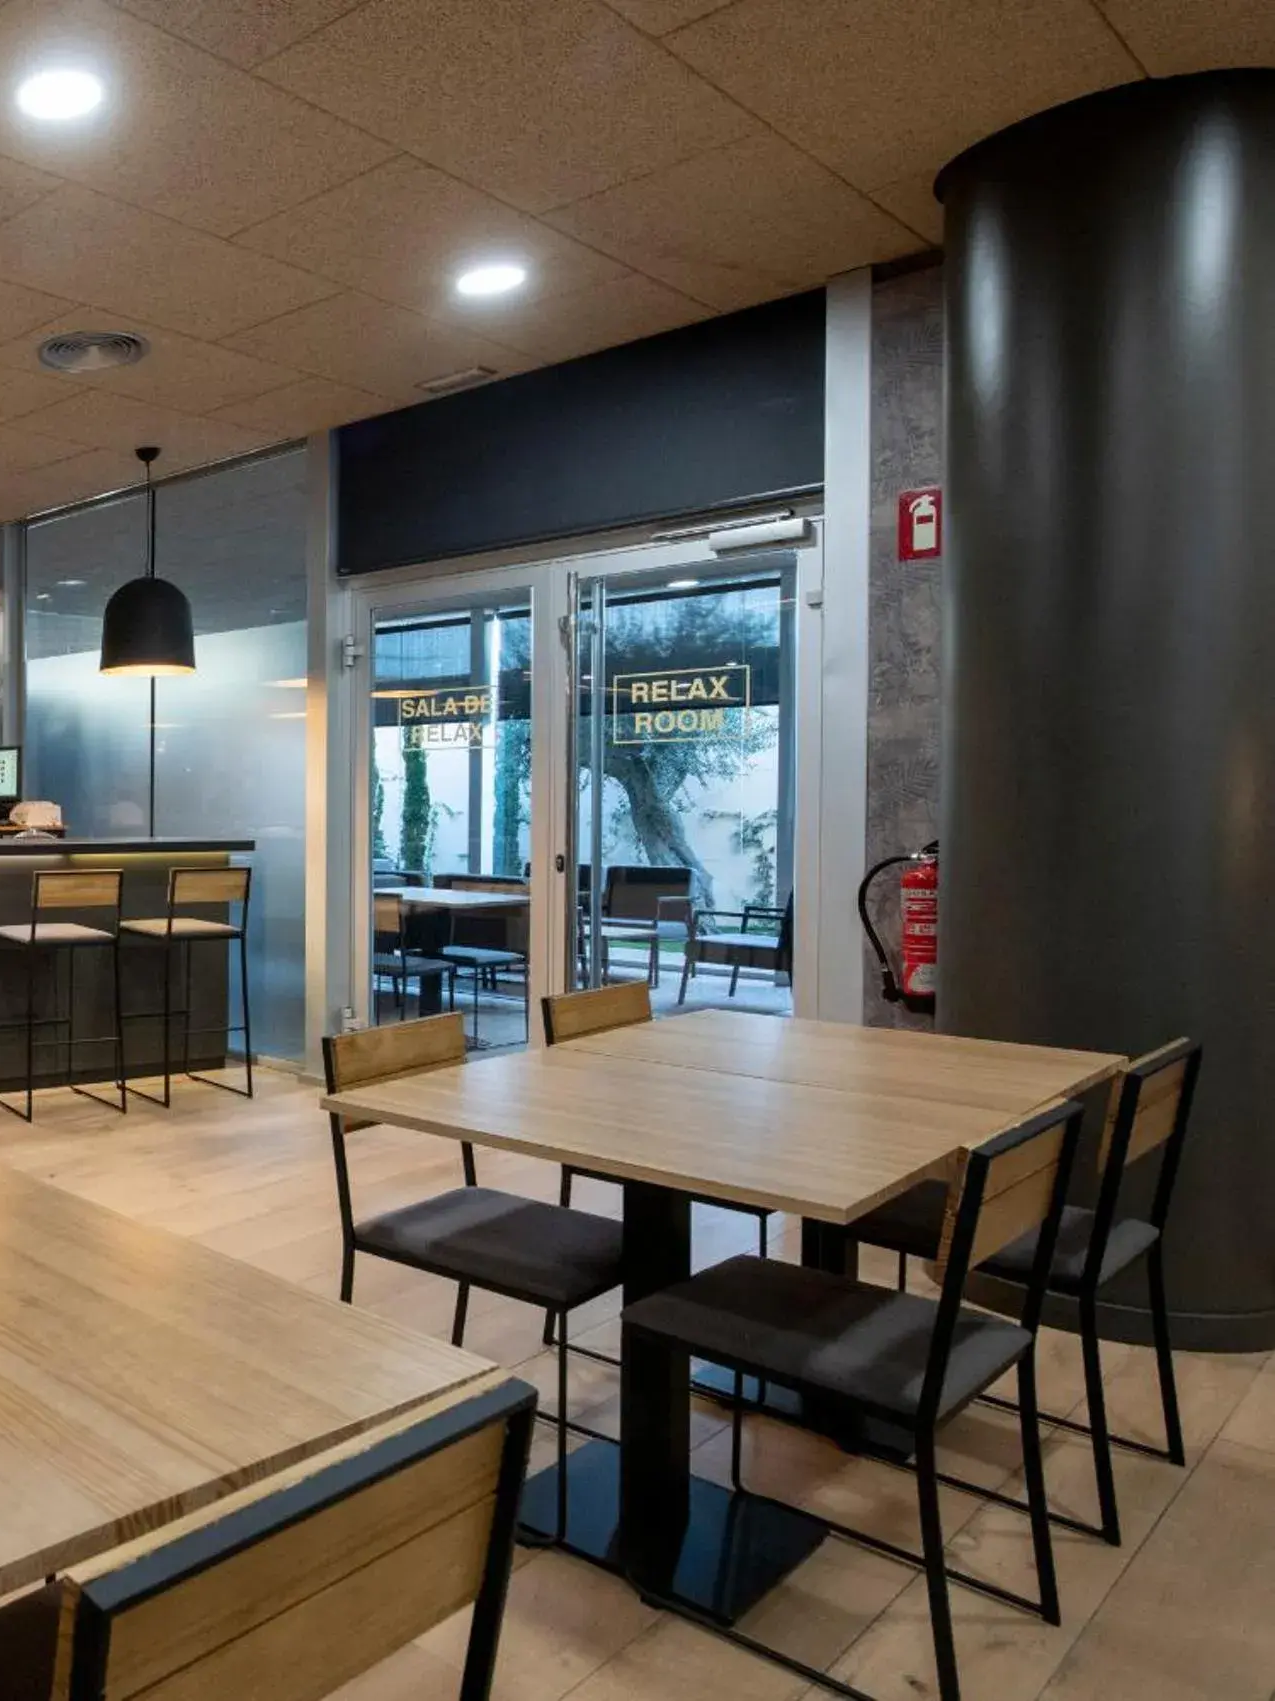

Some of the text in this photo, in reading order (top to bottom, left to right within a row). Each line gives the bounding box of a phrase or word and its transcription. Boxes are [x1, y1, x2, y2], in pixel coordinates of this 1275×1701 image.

[630, 676, 730, 704] RELAX
[402, 694, 492, 719] SALA DE
[411, 721, 483, 743] RELAX
[635, 708, 724, 734] ROOM
